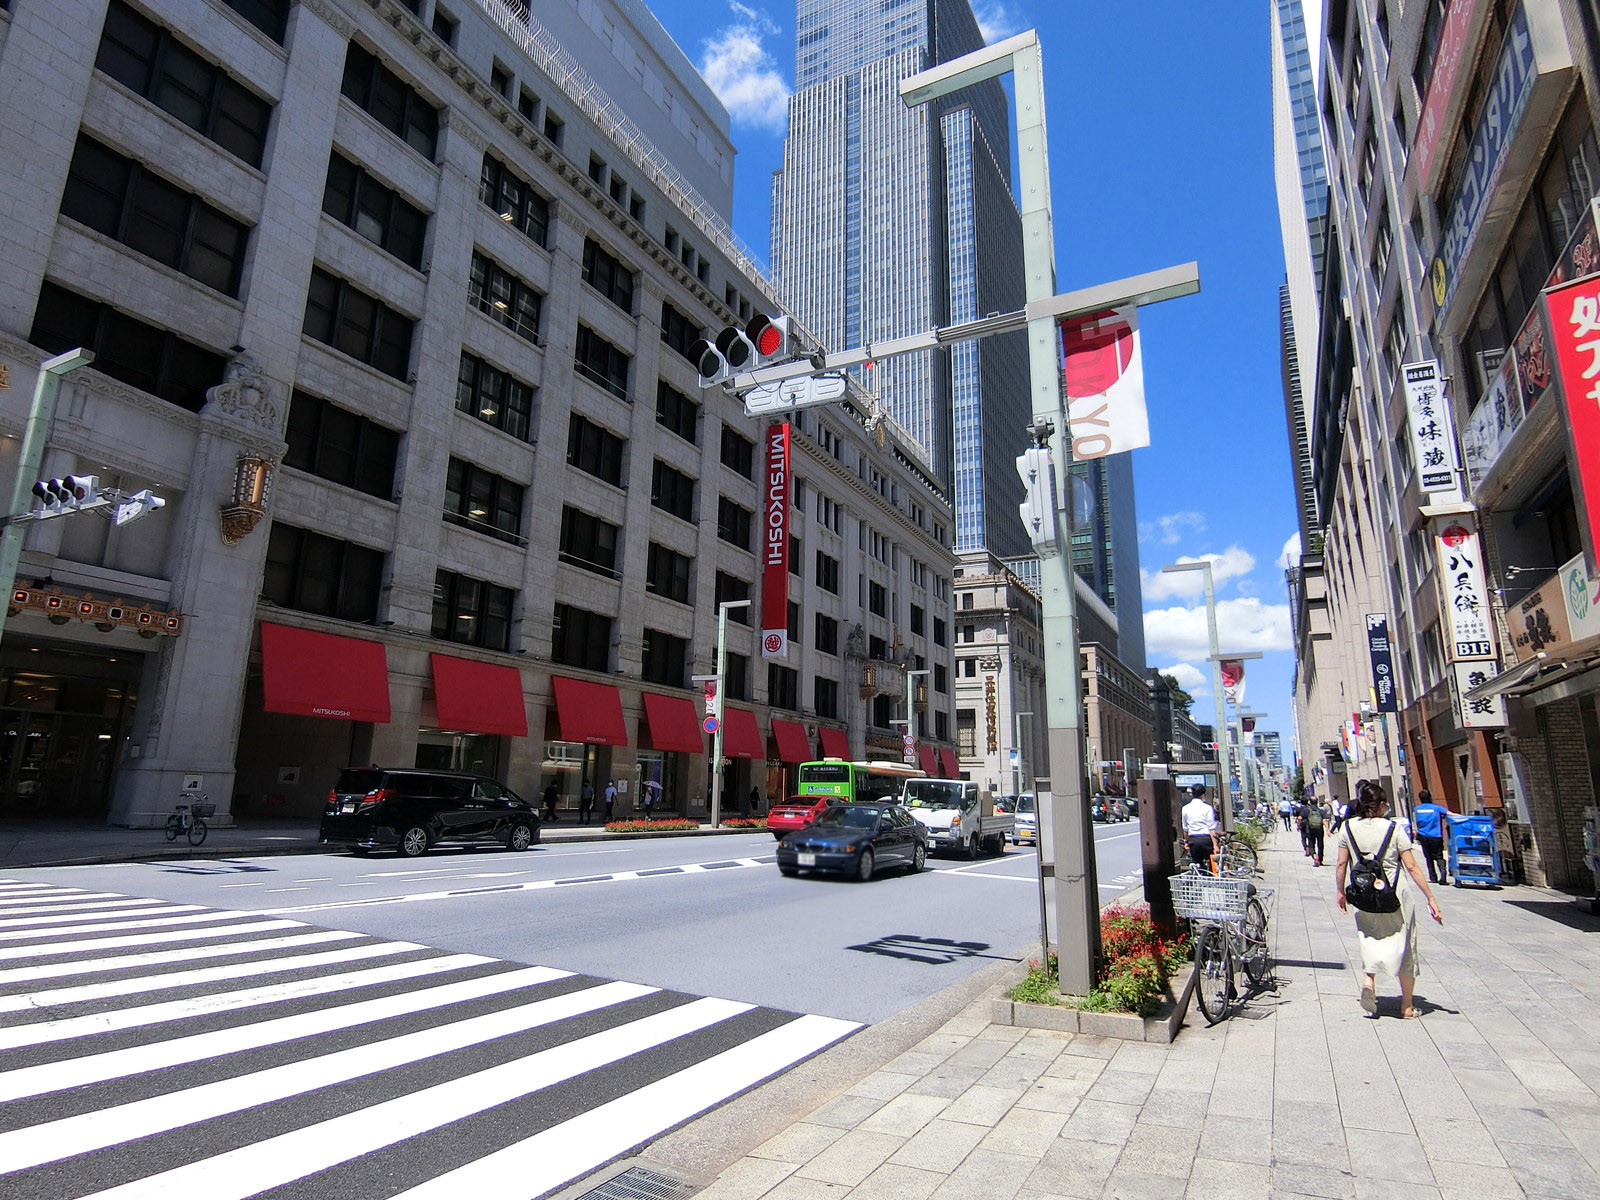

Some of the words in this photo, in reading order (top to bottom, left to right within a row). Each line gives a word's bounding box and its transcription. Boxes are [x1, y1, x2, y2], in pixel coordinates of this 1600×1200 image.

[1444, 23, 1530, 273] 中央コンタクト
[768, 433, 785, 566] MITSUKOSHI
[1457, 641, 1490, 656] B1F
[312, 707, 351, 717] MITSUKOSHI
